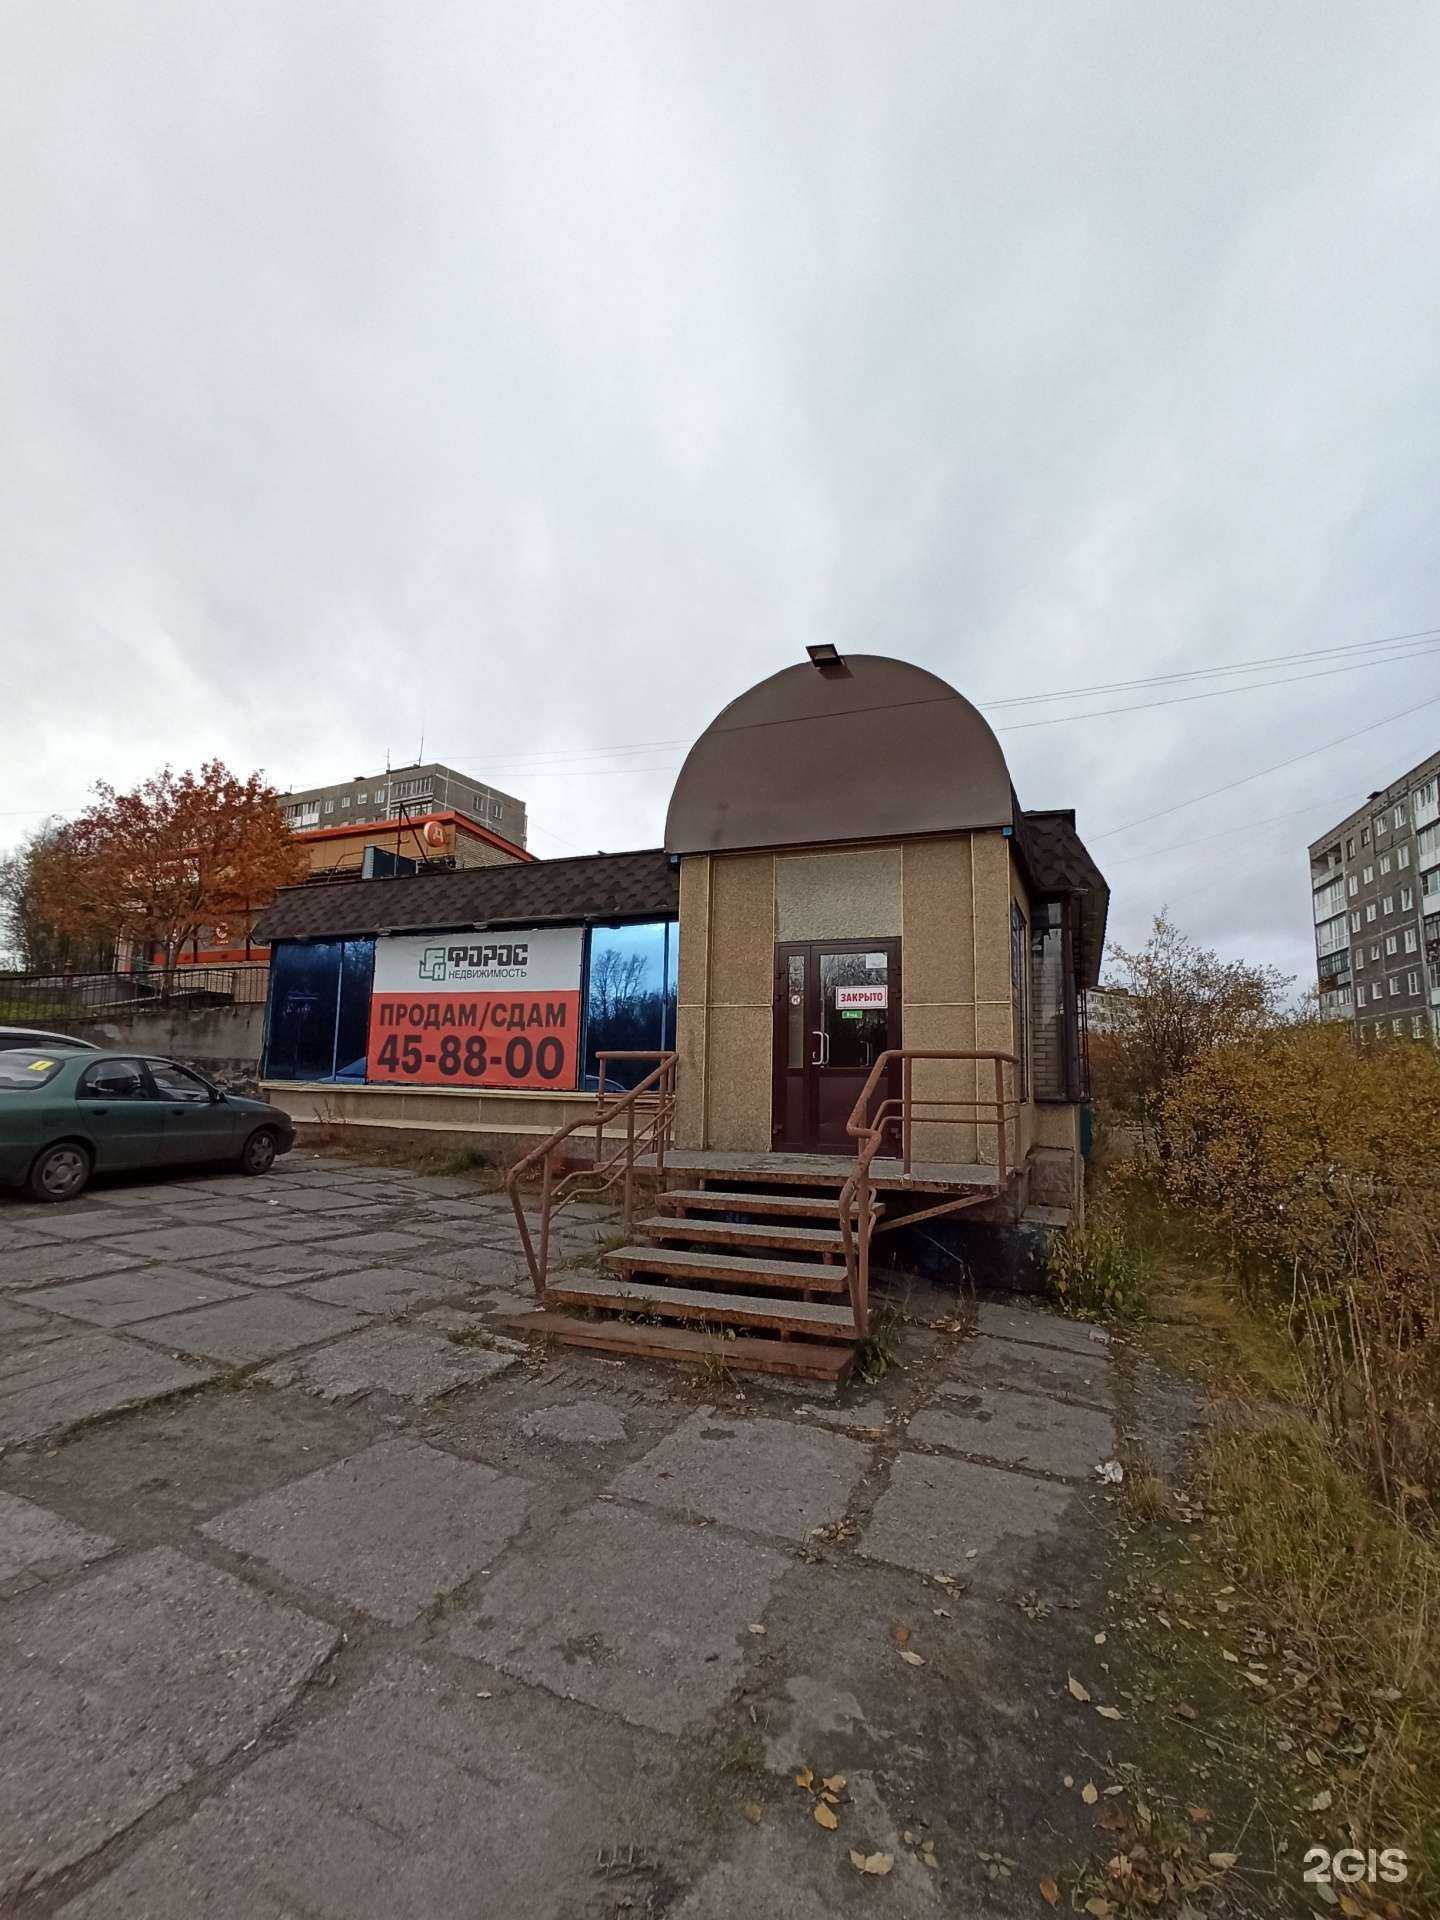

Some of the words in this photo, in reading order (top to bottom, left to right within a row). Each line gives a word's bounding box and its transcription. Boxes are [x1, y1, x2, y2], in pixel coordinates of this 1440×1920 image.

[448, 944, 528, 967] ФОРОС
[448, 968, 527, 980] НЕДВИЖИМОСТЬ
[840, 992, 882, 1002] ЗАКРЫТО
[377, 1034, 564, 1079] 45-88-00
